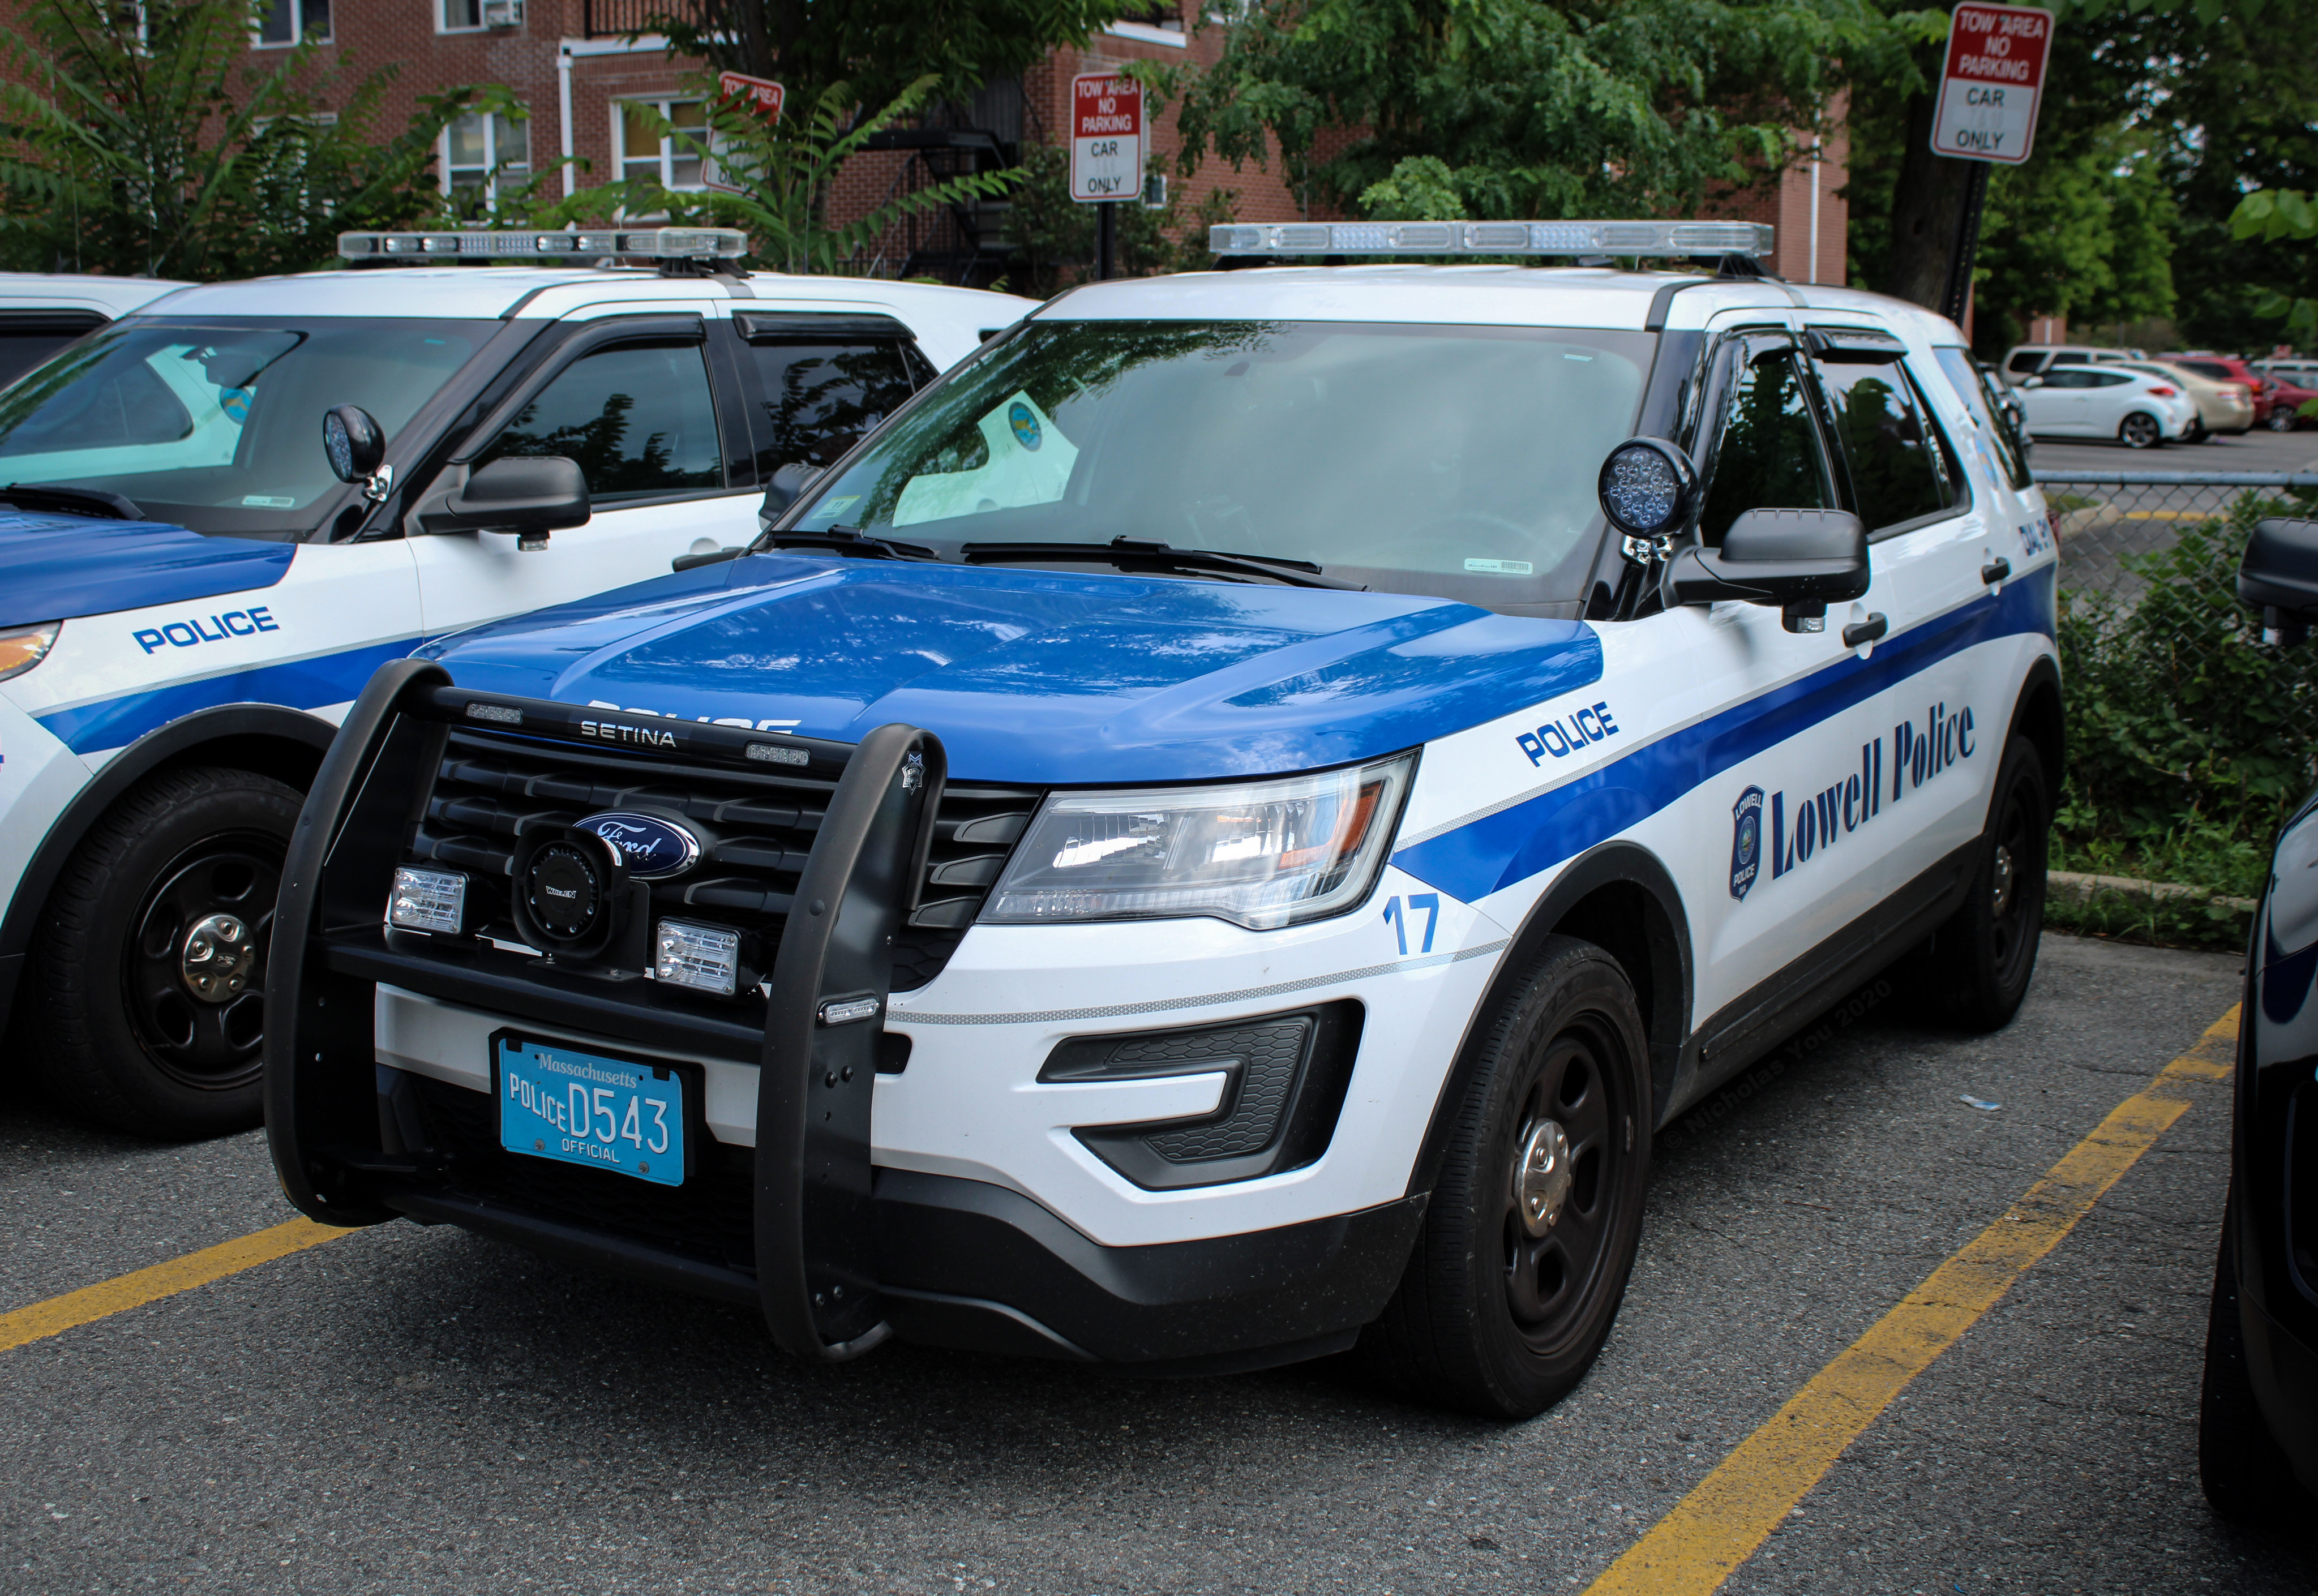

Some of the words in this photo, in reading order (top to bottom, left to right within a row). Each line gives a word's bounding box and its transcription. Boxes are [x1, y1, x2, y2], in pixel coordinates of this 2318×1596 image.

[1959, 10, 1996, 33] TOW
[1998, 15, 2044, 39] AREA
[1984, 35, 2011, 57] NO
[1958, 54, 2030, 81] PARKING
[1077, 80, 1103, 98] TOW
[1106, 79, 1139, 96] AREA
[1966, 87, 2005, 108] CAR
[1098, 96, 1116, 114] NO
[1082, 114, 1132, 133] PARKING
[1091, 141, 1119, 157] CAR
[1957, 129, 2004, 151] ONLY
[1087, 176, 1121, 193] ONLY
[131, 606, 280, 655] POLICE
[581, 720, 677, 748] SETINA
[1515, 701, 1619, 767] POLICE
[1772, 737, 1881, 881] Lowell
[1893, 701, 1976, 803] Police
[1735, 793, 1762, 821] LOWELL
[1733, 863, 1755, 887] POLICE
[546, 885, 576, 899] WHELEN
[1739, 885, 1747, 896] MA
[1382, 893, 1439, 955] 17
[539, 1053, 637, 1088] Massachusetts
[510, 1072, 567, 1133] POLICE
[568, 1082, 669, 1154] D543
[562, 1138, 620, 1164] OFFICIAL
